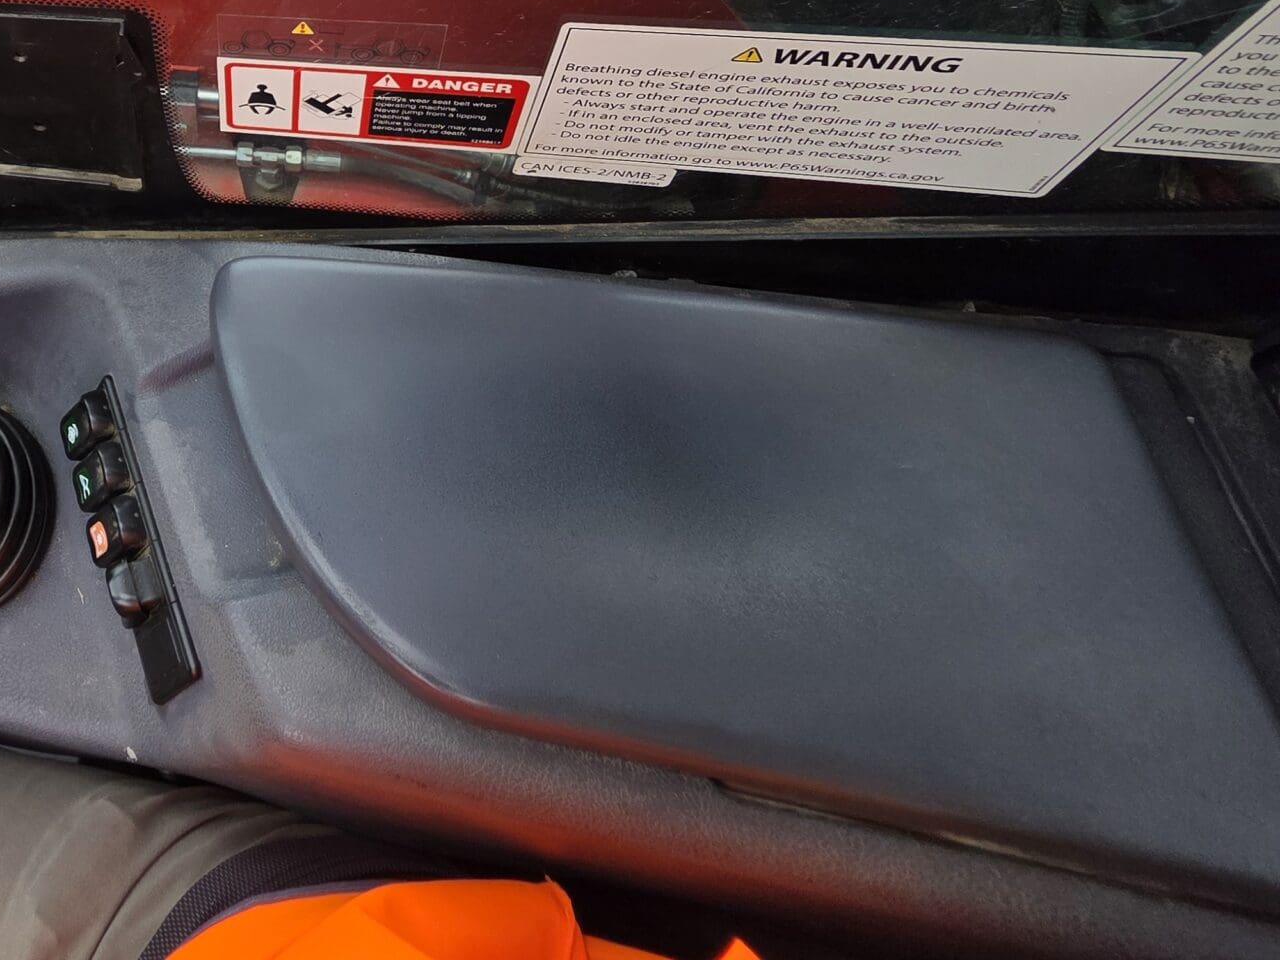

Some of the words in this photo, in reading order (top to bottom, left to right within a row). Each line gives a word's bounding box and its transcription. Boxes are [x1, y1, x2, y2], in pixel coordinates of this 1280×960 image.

[774, 48, 964, 74] WARNING
[1229, 52, 1278, 62] you
[1217, 65, 1241, 74] to
[412, 78, 513, 94] DANGER
[565, 63, 642, 77] Breathing
[646, 67, 695, 79] diesel
[698, 72, 756, 83] engine
[761, 75, 830, 87] exhaust
[833, 80, 909, 91] exposes
[911, 85, 945, 94] you
[950, 86, 969, 95] to
[973, 87, 1070, 101] chemicals
[1200, 80, 1264, 91] cause
[556, 86, 611, 98] defects
[635, 92, 679, 102] other
[682, 94, 789, 109] reproductive
[792, 101, 840, 112] harm.
[561, 75, 613, 86] known
[618, 78, 634, 88] to
[641, 79, 665, 89] the
[669, 81, 711, 92] State
[714, 85, 733, 93] of
[736, 86, 816, 98] California
[820, 91, 838, 100] to
[842, 94, 894, 103] cause
[897, 97, 959, 107] cancer
[961, 101, 1001, 110] and
[1002, 102, 1053, 113] birth
[1184, 93, 1264, 105] defects
[375, 102, 416, 110] operating
[456, 113, 487, 121] tipping
[572, 99, 625, 110] Always
[629, 103, 665, 113] start
[669, 105, 699, 115] and
[703, 109, 767, 120] operate
[770, 112, 799, 121] the
[802, 116, 862, 128] engine
[865, 119, 882, 127] in
[901, 122, 1037, 137] well-ventilated
[1038, 132, 1082, 141] area.
[404, 127, 428, 135] injury
[414, 122, 446, 130] comply
[568, 110, 582, 118] If
[583, 111, 595, 119] in
[622, 115, 692, 126] enclosed
[694, 120, 731, 129] area,
[738, 123, 773, 132] vent
[777, 124, 805, 133] the
[808, 128, 876, 139] exhaust
[879, 132, 897, 140] to
[902, 133, 931, 142] the
[935, 135, 1004, 148] outside.
[1147, 123, 1183, 133] For
[1184, 127, 1240, 138] more
[564, 120, 586, 129] Do
[589, 123, 615, 131] not
[618, 125, 671, 137] modify
[696, 131, 757, 142] tamper
[758, 136, 793, 145] with
[797, 138, 825, 147] the
[828, 141, 896, 152] exhaust
[899, 145, 963, 156] system.
[560, 131, 581, 139] Do
[585, 133, 610, 141] not
[614, 135, 641, 144] idle
[645, 137, 670, 146] the
[673, 140, 727, 152] engine
[730, 144, 783, 156] except
[808, 151, 892, 164] necessary.
[535, 143, 557, 151] For
[561, 147, 599, 155] more
[602, 149, 689, 162] information
[692, 157, 712, 165] go
[736, 160, 944, 182] www.P65Warnings.ca.gov
[521, 162, 554, 172] CAN
[558, 165, 667, 181] ICES-2/NMB-2
